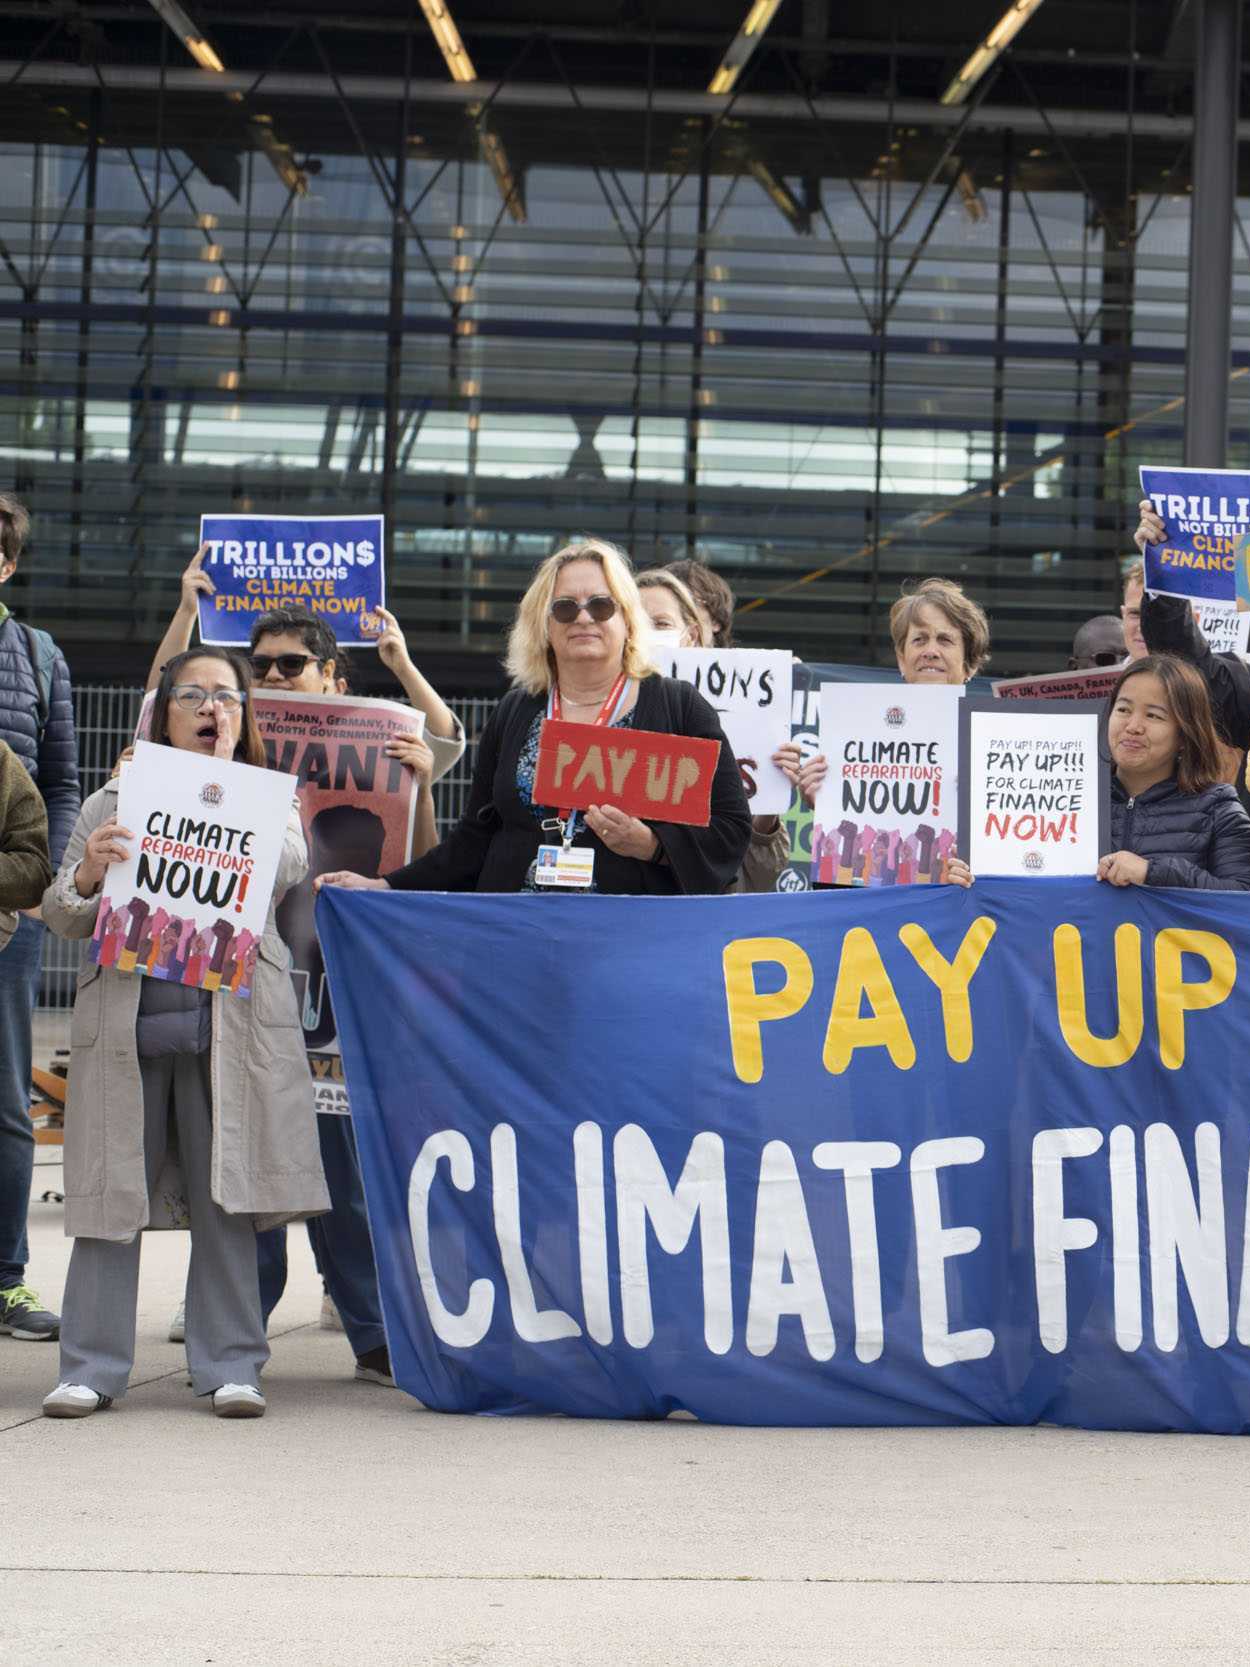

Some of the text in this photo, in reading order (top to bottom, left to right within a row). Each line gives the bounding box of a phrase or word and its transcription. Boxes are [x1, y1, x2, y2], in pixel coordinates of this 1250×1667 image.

[1178, 520, 1209, 534] NOT
[233, 565, 348, 580] NOT BILLIONS
[246, 579, 335, 596] CLIMATE
[311, 597, 366, 615] NOW!
[1203, 617, 1241, 636] UP!!!
[844, 741, 939, 764] CLIMATE
[990, 739, 1012, 750] PAY
[1036, 741, 1058, 751] PAY
[842, 764, 943, 780] REPARATIONS
[987, 752, 1085, 772] PAY UP!!!
[554, 741, 637, 797] PAY
[645, 754, 700, 805] UP
[986, 776, 1084, 792] FOR CLIMATE
[842, 779, 940, 816] NOW!
[986, 792, 1082, 813] FINANCE
[146, 811, 256, 856] CLIMATE
[984, 812, 1077, 844] NOW!
[140, 837, 254, 875] REPARATIONS
[136, 853, 249, 913] NOW!
[722, 915, 998, 1084] PAY
[1053, 922, 1237, 1070] UP
[408, 1121, 995, 1367] CLIMATE
